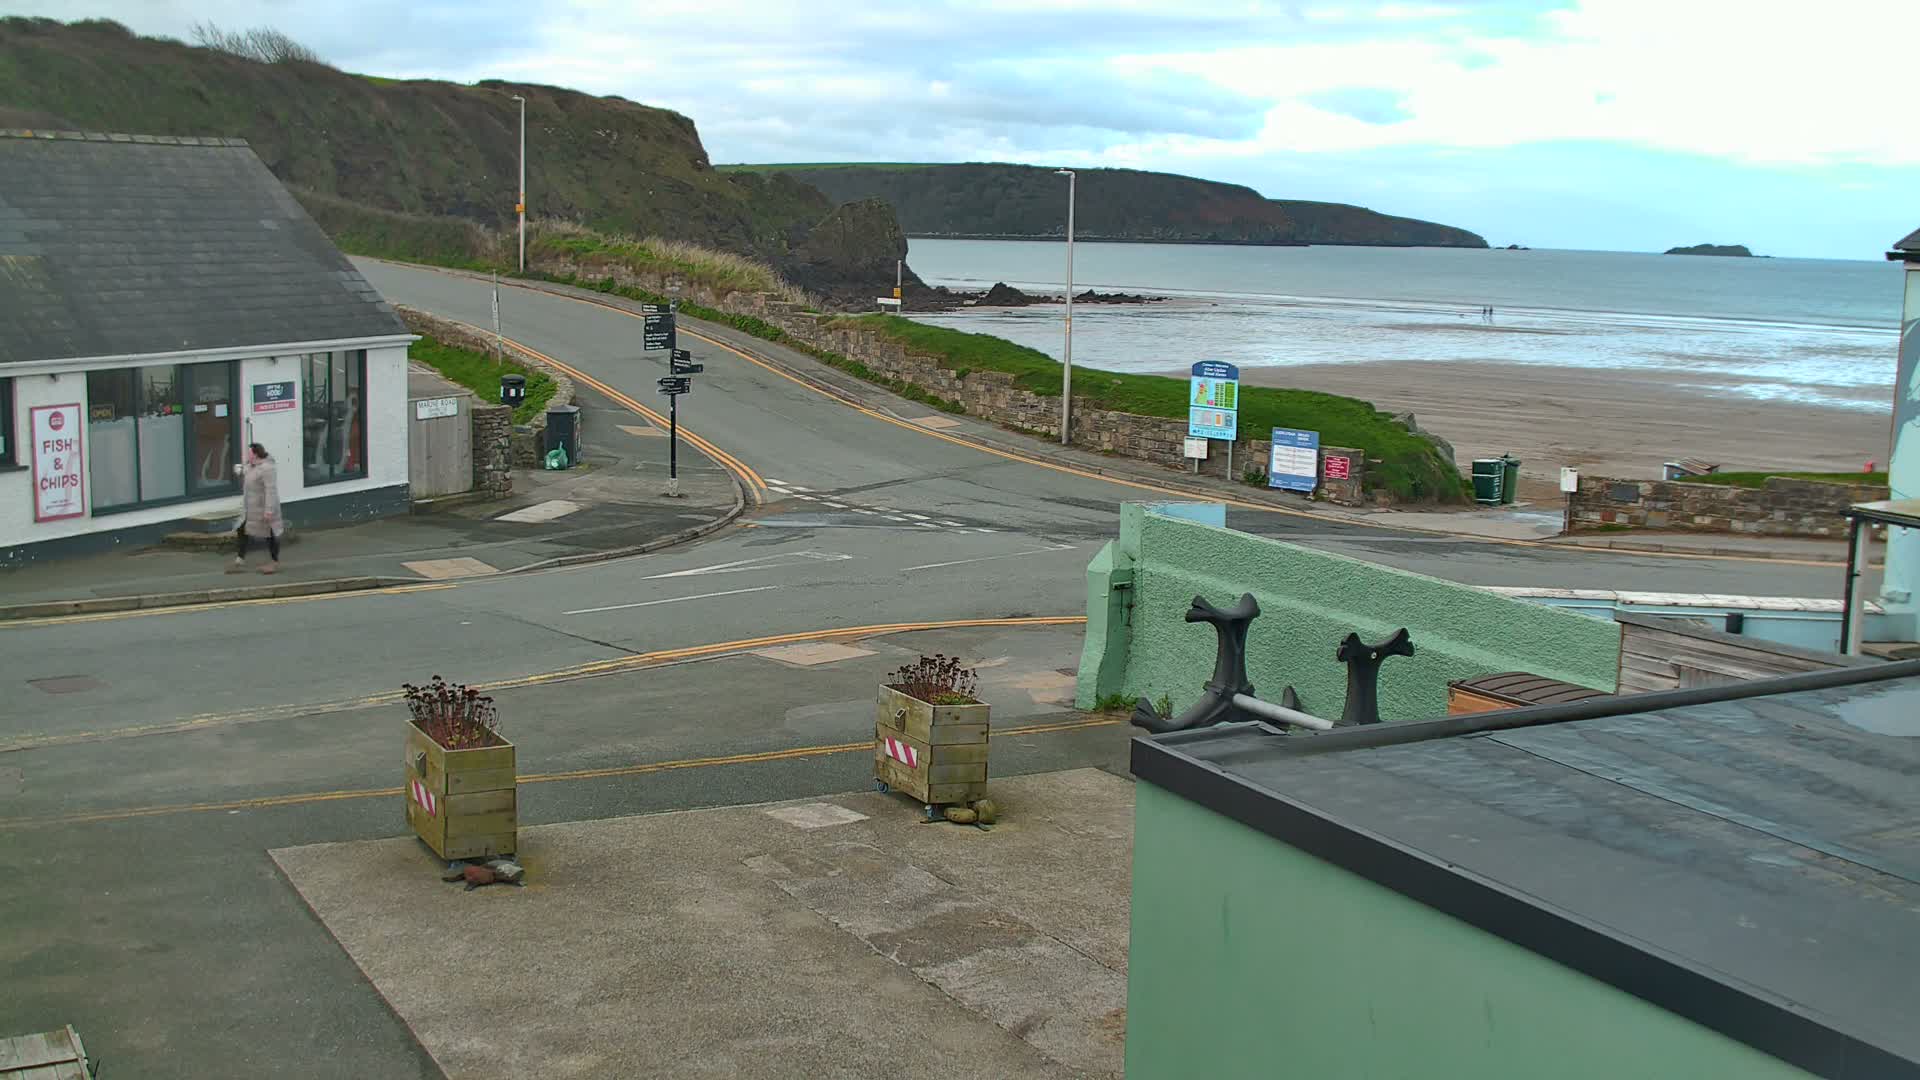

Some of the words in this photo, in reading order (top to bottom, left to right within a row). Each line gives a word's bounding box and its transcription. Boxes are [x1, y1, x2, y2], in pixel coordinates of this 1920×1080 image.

[43, 438, 73, 454] FISH
[53, 457, 63, 471] &
[40, 474, 79, 491] CHIPS
